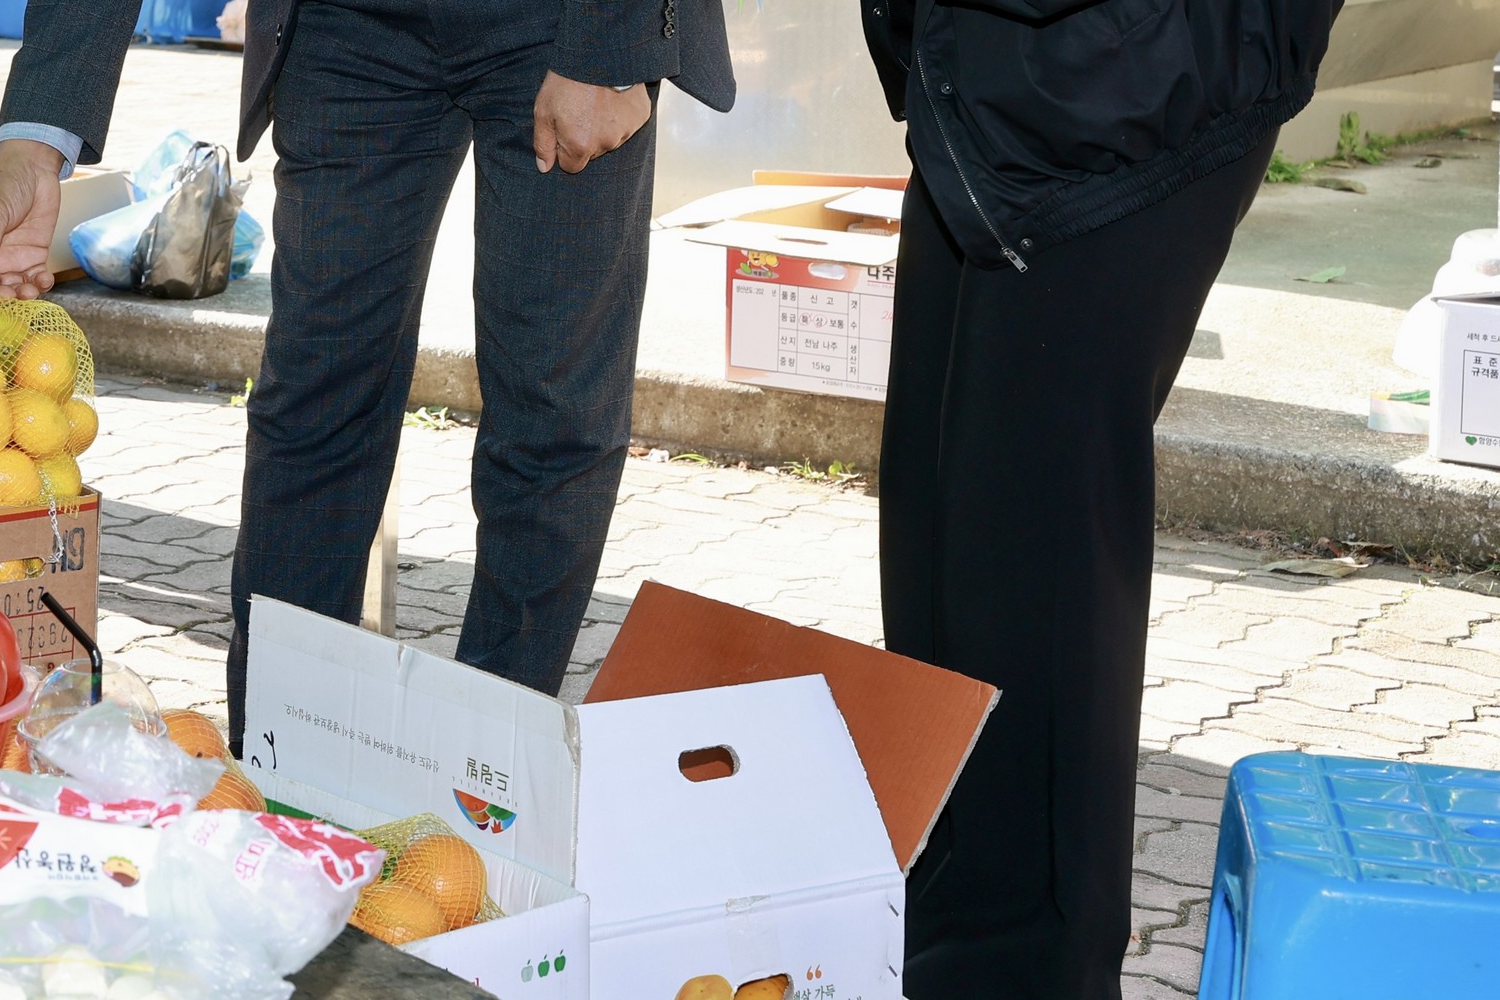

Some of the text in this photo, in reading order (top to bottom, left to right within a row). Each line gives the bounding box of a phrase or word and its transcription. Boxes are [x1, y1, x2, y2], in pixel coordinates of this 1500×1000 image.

[830, 319, 844, 329] 보통
[804, 339, 819, 349] 전남
[823, 341, 838, 351] 나주
[811, 361, 831, 373] 15kg
[1471, 367, 1499, 379] 규격품
[283, 703, 440, 773] 신선도 유지를 위하여 받는 즉시 냉장보관 하십시오
[466, 757, 509, 792] 드림빌
[15, 848, 97, 874] 청원농산
